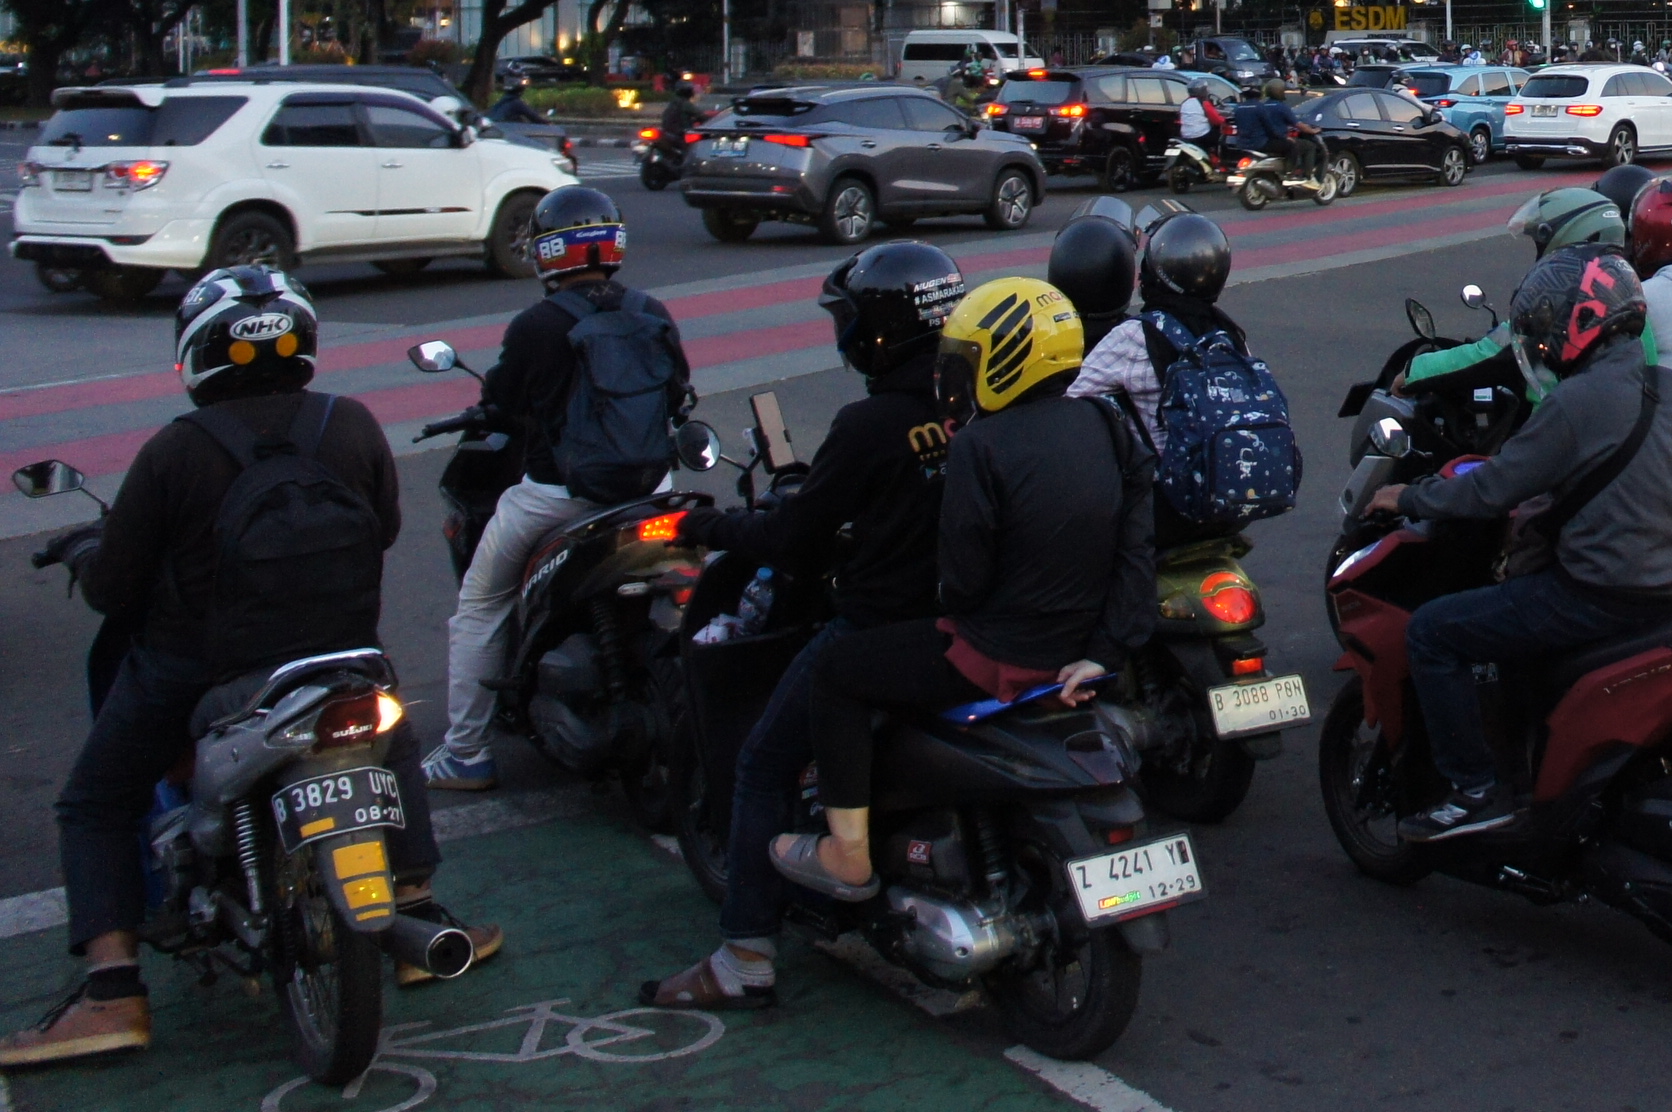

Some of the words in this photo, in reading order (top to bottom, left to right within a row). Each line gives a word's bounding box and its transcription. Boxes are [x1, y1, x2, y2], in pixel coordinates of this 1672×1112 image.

[1335, 6, 1405, 30] ESDM
[540, 238, 566, 259] 88
[239, 317, 284, 335] NHK
[522, 549, 569, 598] VARIO
[1215, 693, 1224, 711] B
[1233, 686, 1268, 707] 3088
[332, 724, 373, 739] SUZUKI
[274, 798, 287, 823] B
[292, 776, 352, 812] 3829
[369, 772, 397, 798] UYC
[1076, 865, 1092, 889] Z
[1109, 849, 1153, 881] 4241
